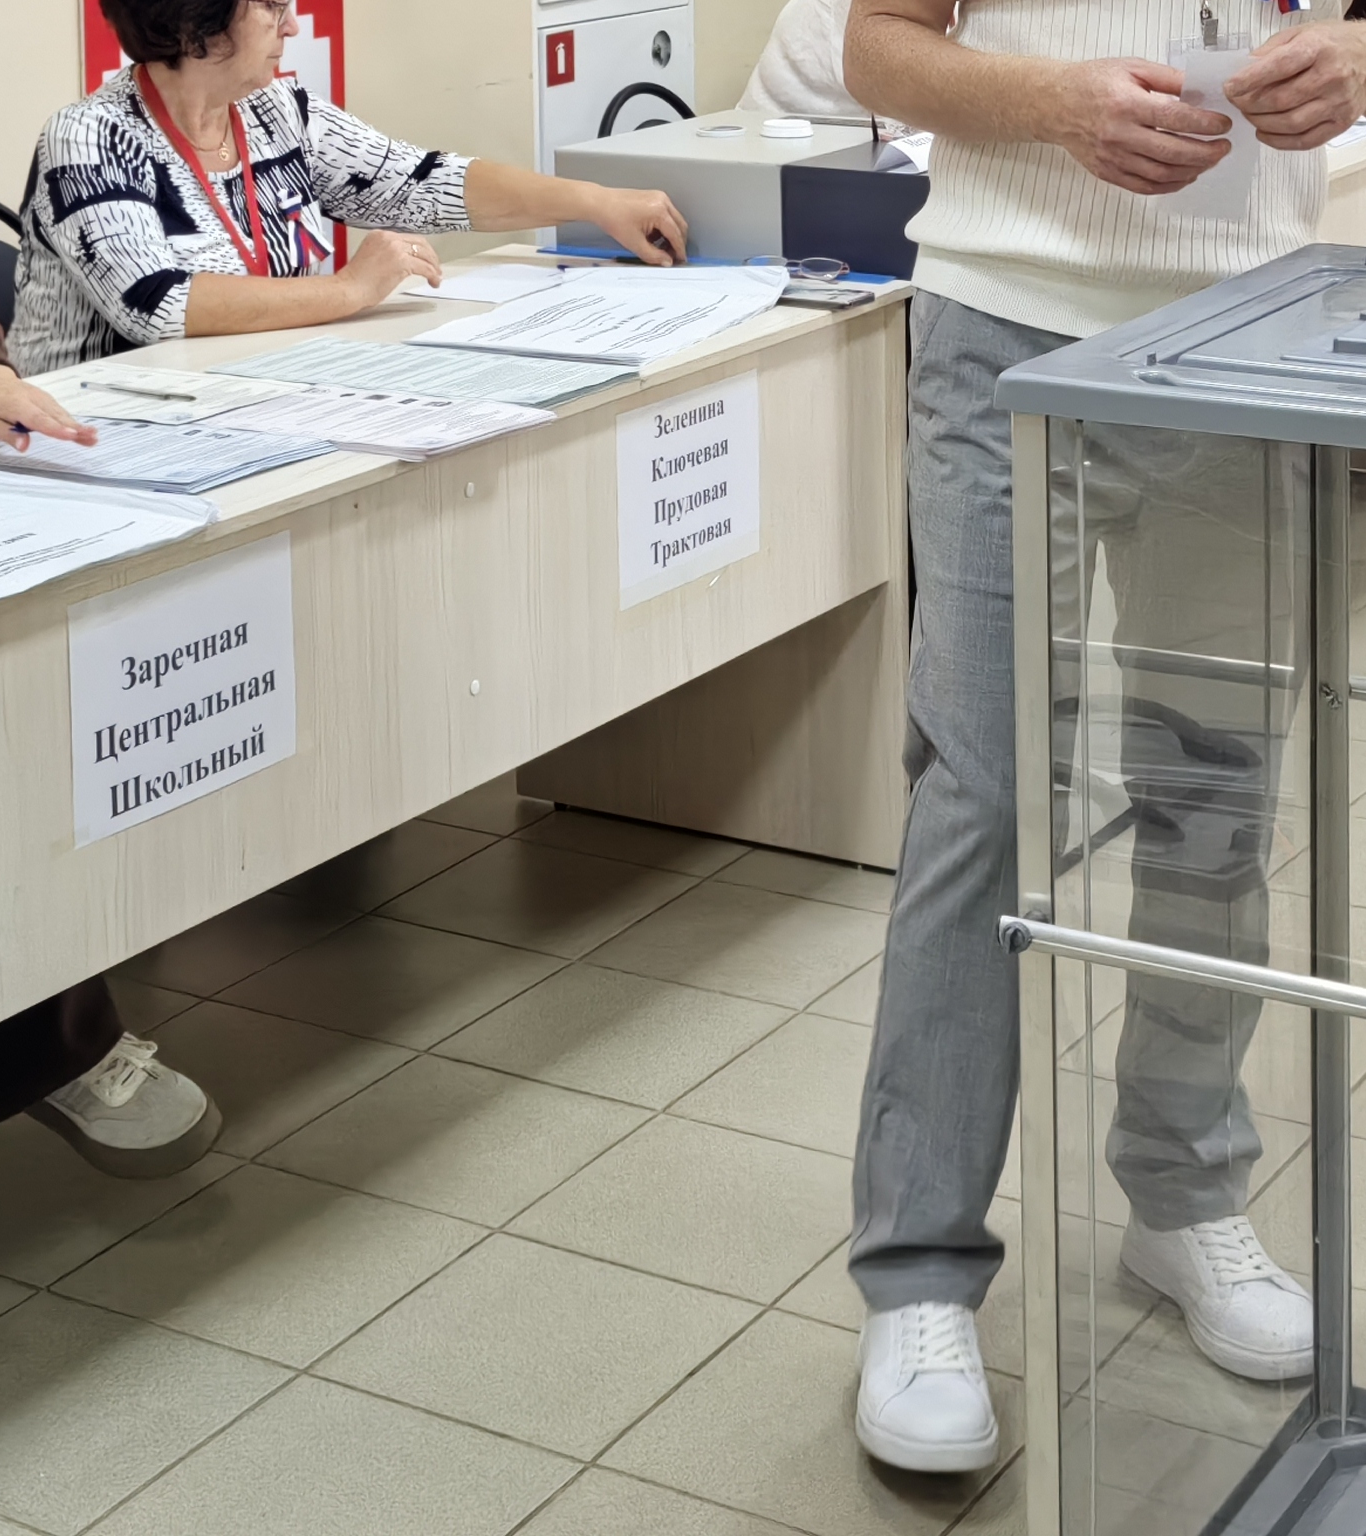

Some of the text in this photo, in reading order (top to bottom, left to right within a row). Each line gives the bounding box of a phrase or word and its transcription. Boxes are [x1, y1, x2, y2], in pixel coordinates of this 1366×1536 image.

[654, 399, 725, 439] Зеленина
[651, 438, 730, 483] Ключевая
[653, 480, 728, 525] Прудовая
[650, 517, 732, 568] Трактовая
[120, 622, 249, 691] Заречная
[93, 669, 277, 765] Центральная
[109, 723, 266, 820] Школьный
